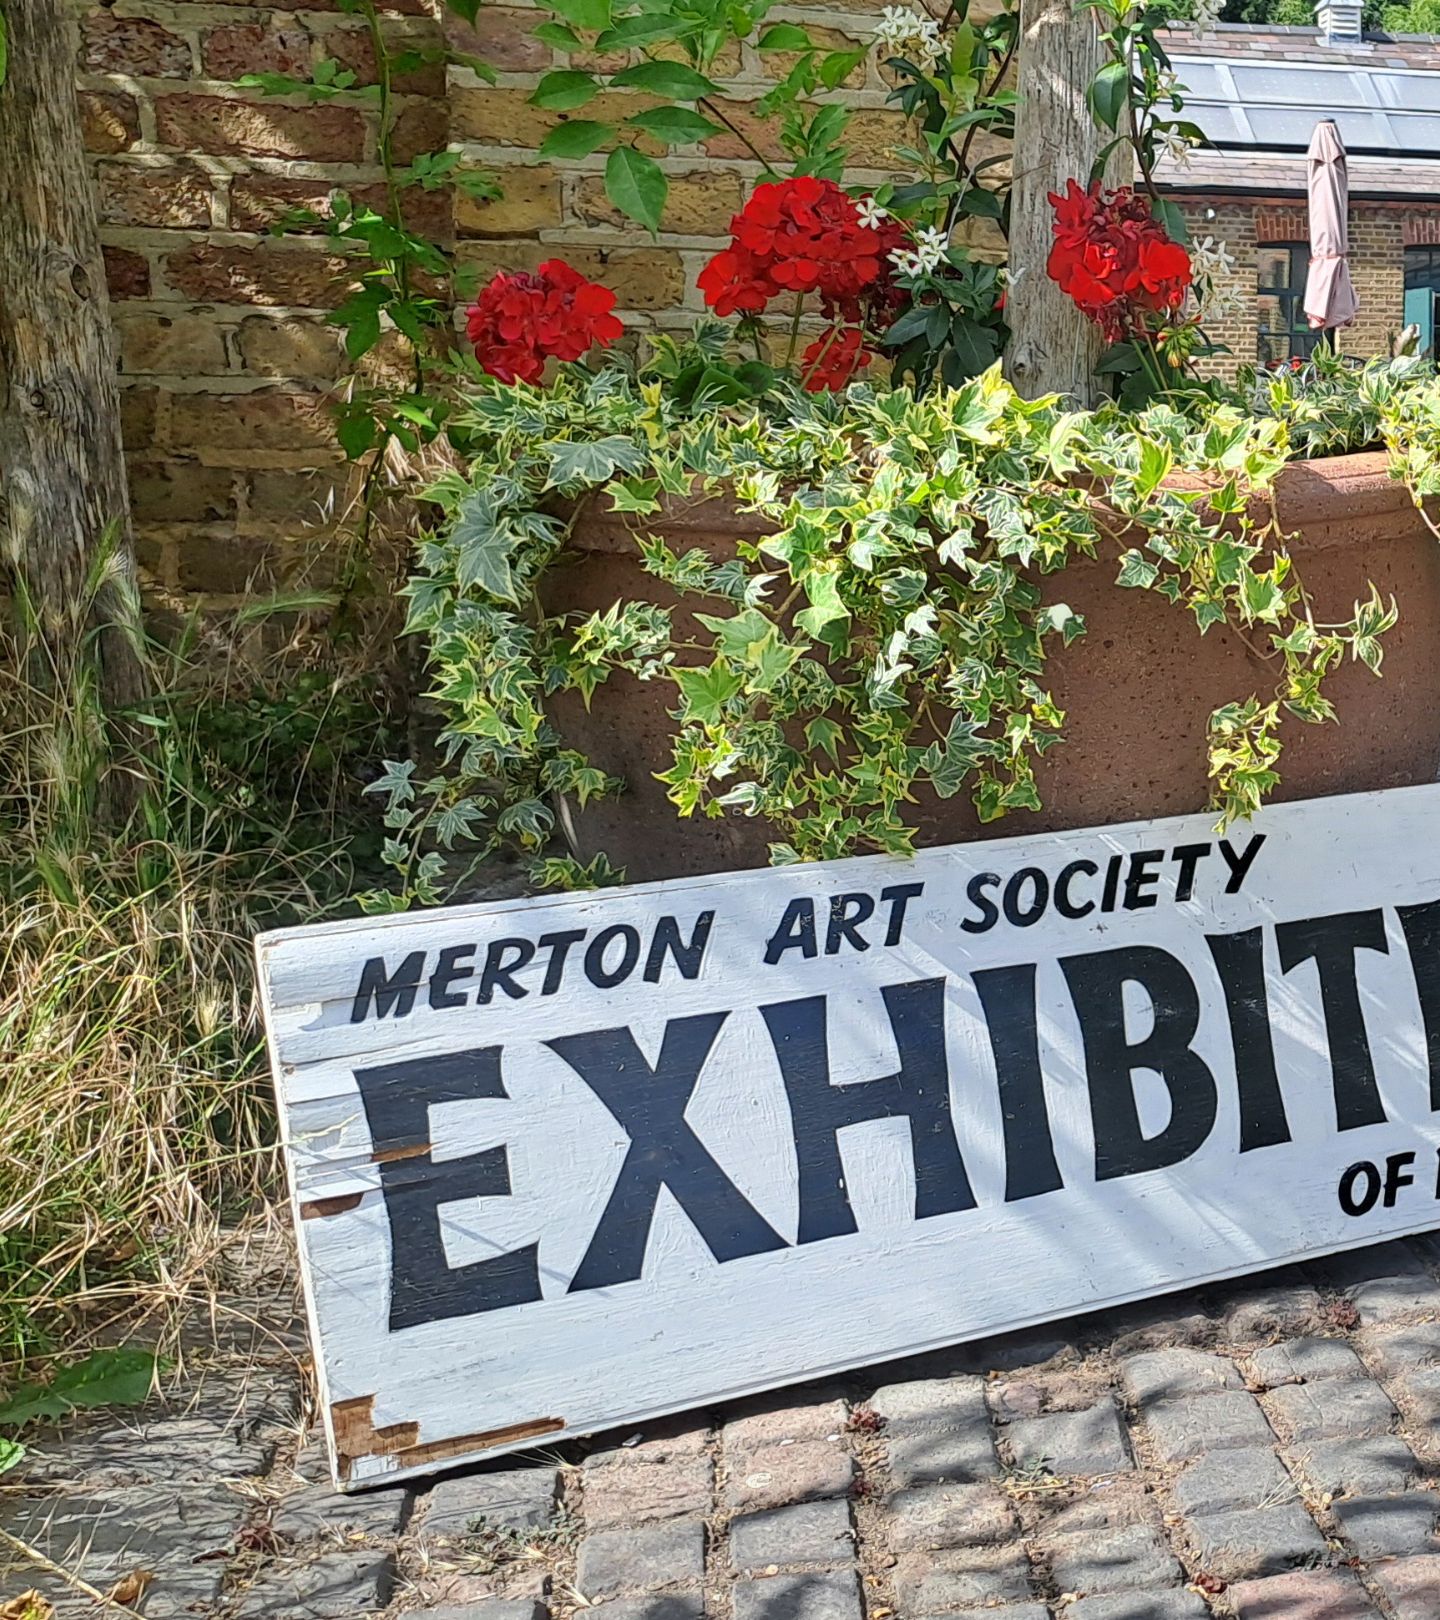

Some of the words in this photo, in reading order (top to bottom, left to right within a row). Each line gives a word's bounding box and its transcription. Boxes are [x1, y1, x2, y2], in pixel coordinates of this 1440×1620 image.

[350, 910, 716, 1023] MERTON
[764, 882, 925, 966] ART
[960, 834, 1269, 934] SOCIETY
[1338, 1151, 1416, 1217] OF
